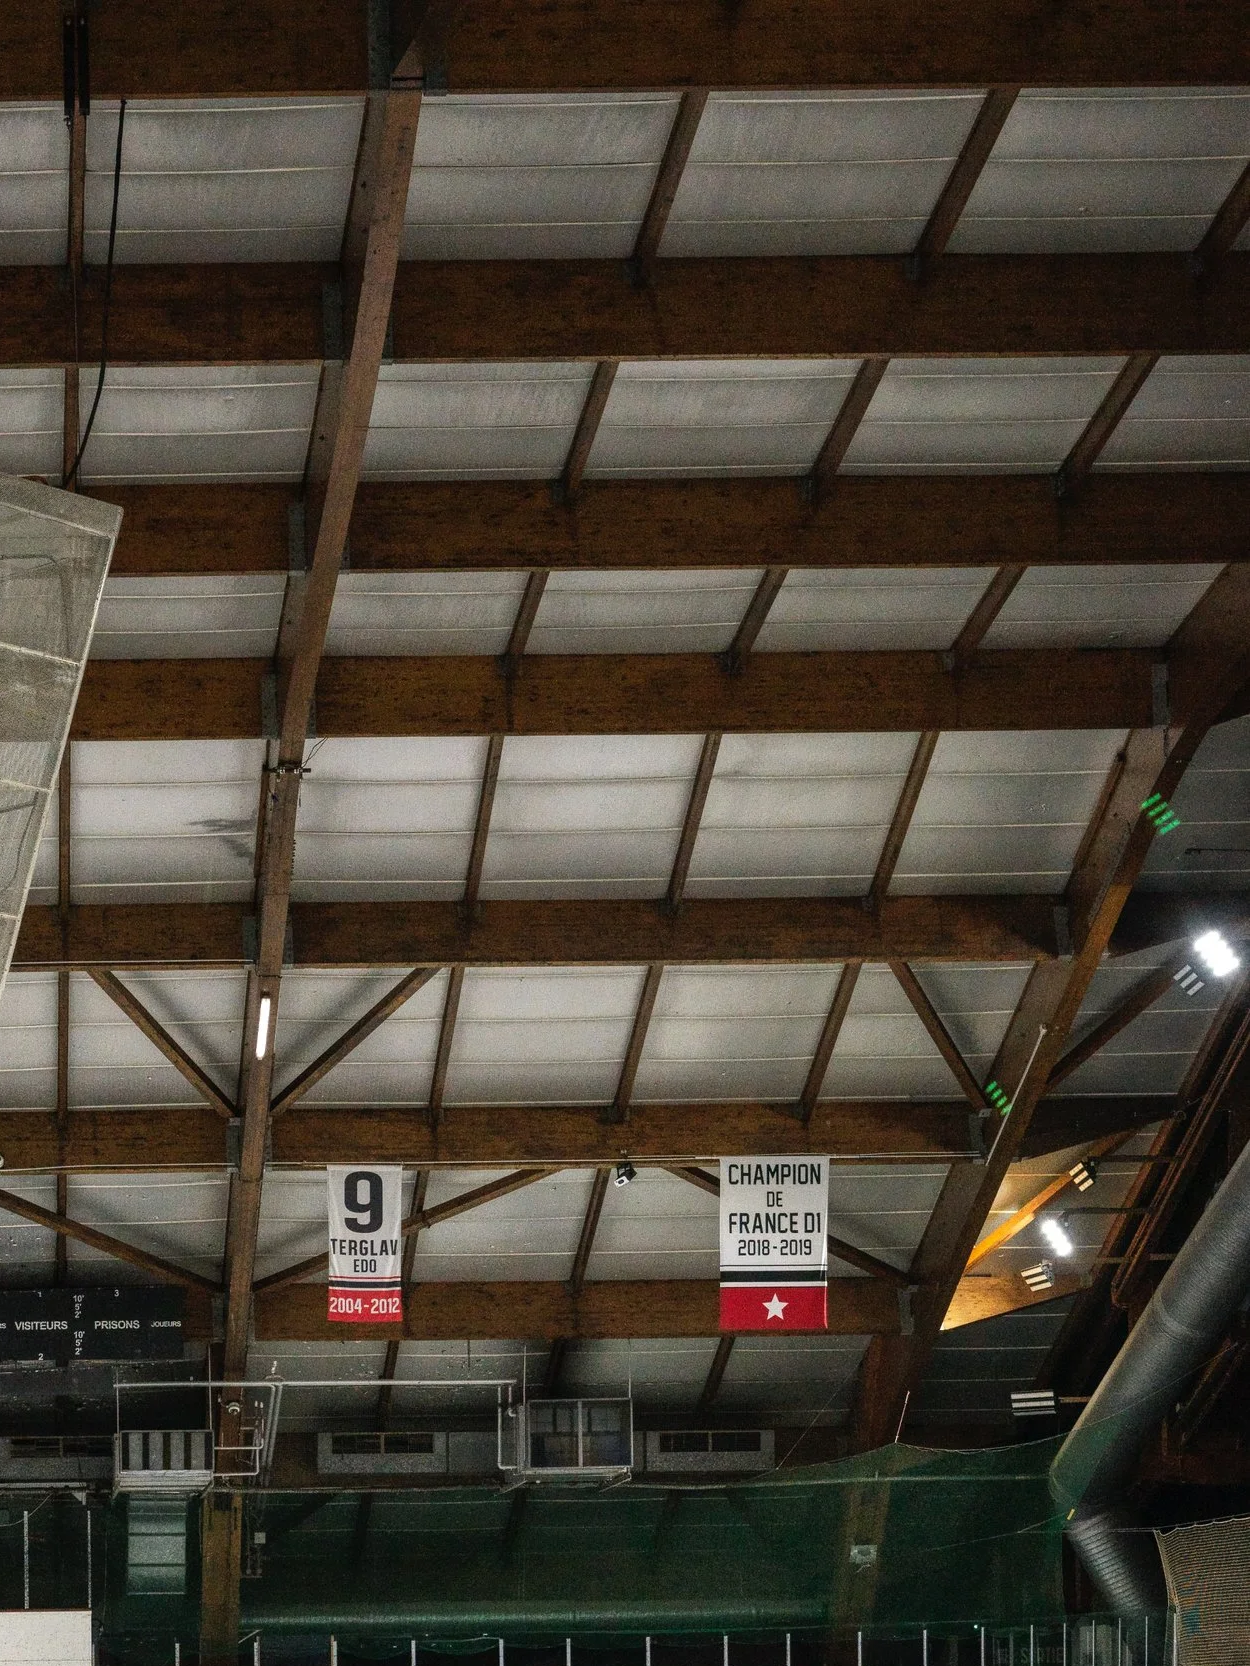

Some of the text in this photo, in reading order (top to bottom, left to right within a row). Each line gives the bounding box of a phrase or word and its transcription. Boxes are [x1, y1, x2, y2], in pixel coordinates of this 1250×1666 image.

[728, 1164, 821, 1185] CHAMPION
[344, 1171, 383, 1233] 9
[766, 1191, 783, 1207] DE
[728, 1213, 821, 1233] FRANCE D1
[330, 1238, 398, 1256] TERGLAV
[738, 1239, 812, 1256] 2018-2019
[353, 1259, 377, 1273] EDO
[114, 1289, 120, 1297] 3
[329, 1297, 400, 1314] 2004-2012
[14, 1321, 68, 1330] VISITEURS
[94, 1320, 140, 1329] PRISONS
[38, 1353, 44, 1361] 2
